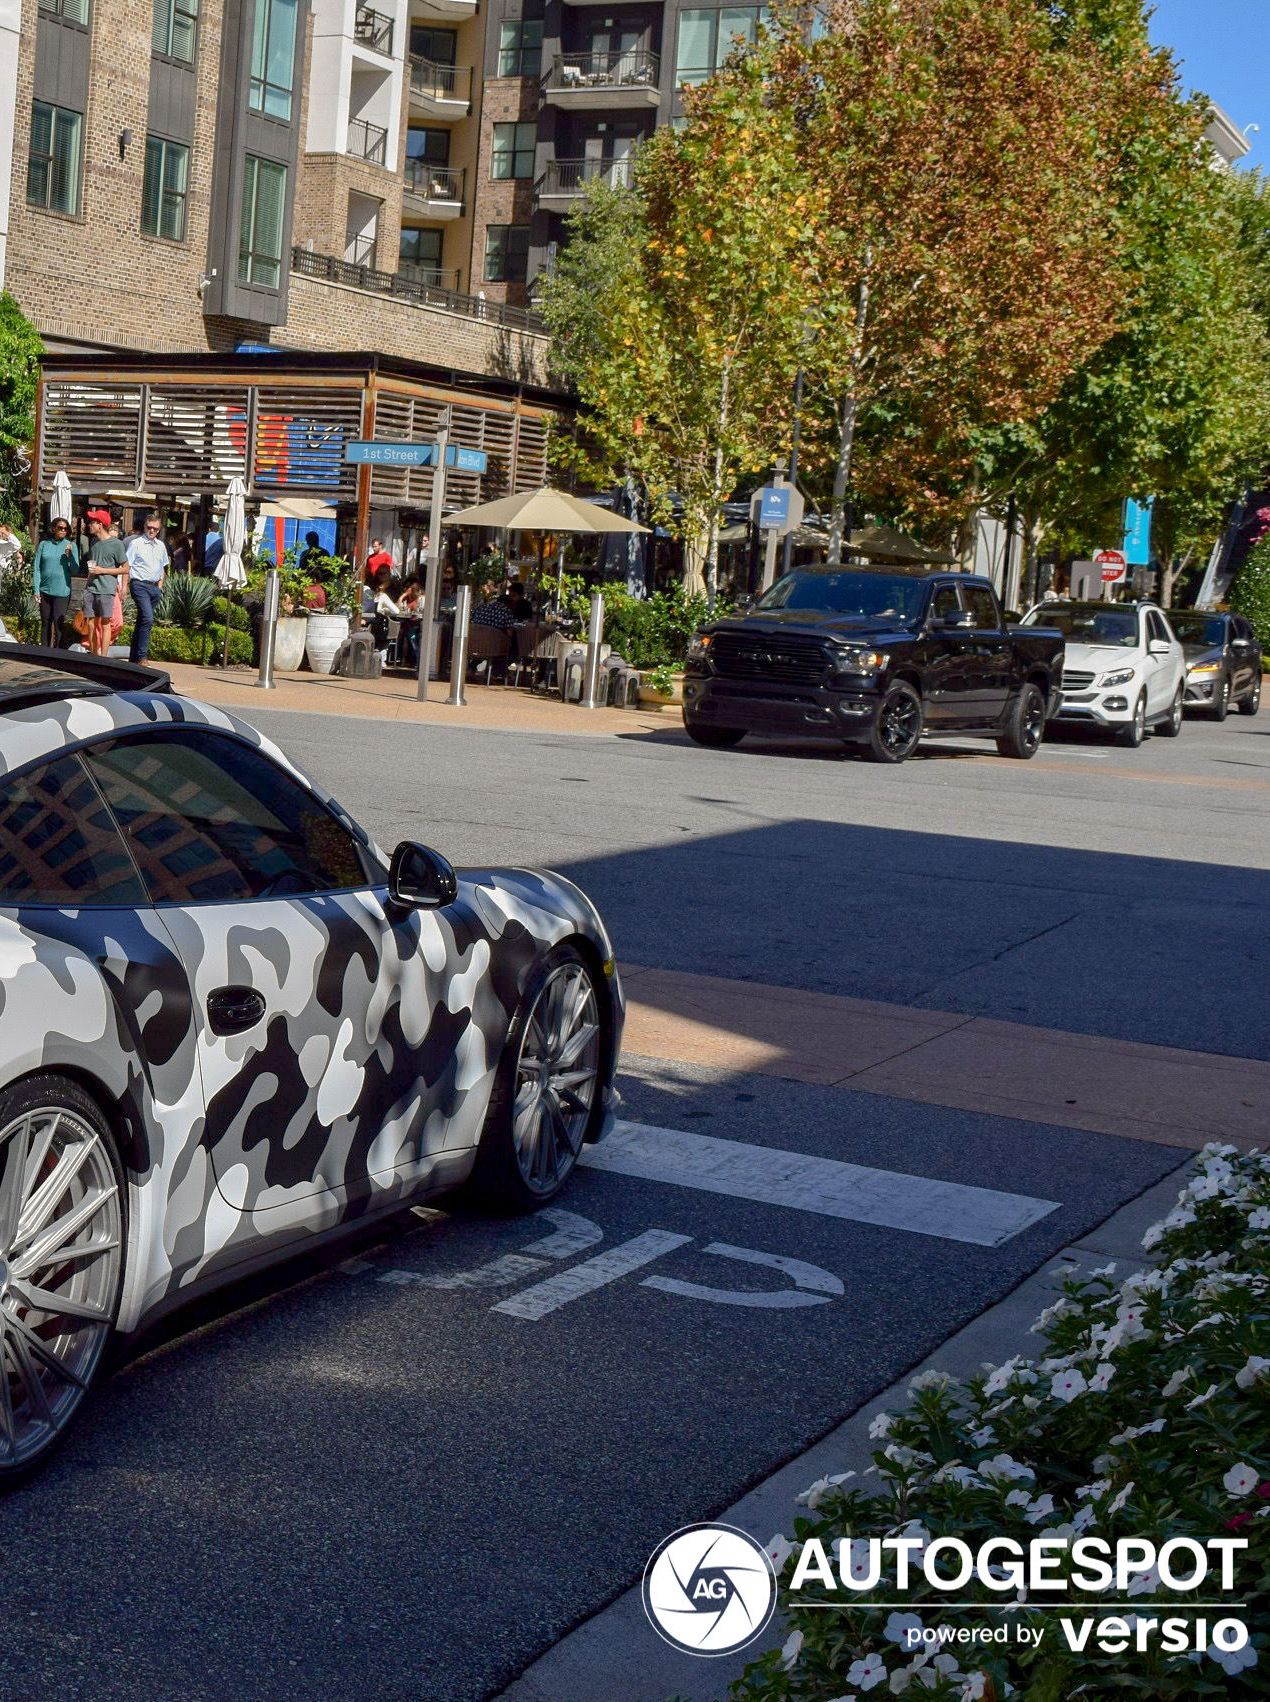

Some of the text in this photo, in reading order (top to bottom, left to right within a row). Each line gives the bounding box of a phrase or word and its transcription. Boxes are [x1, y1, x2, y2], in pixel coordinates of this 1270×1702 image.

[362, 447, 419, 461] 1st Street
[1101, 569, 1118, 577] NTER
